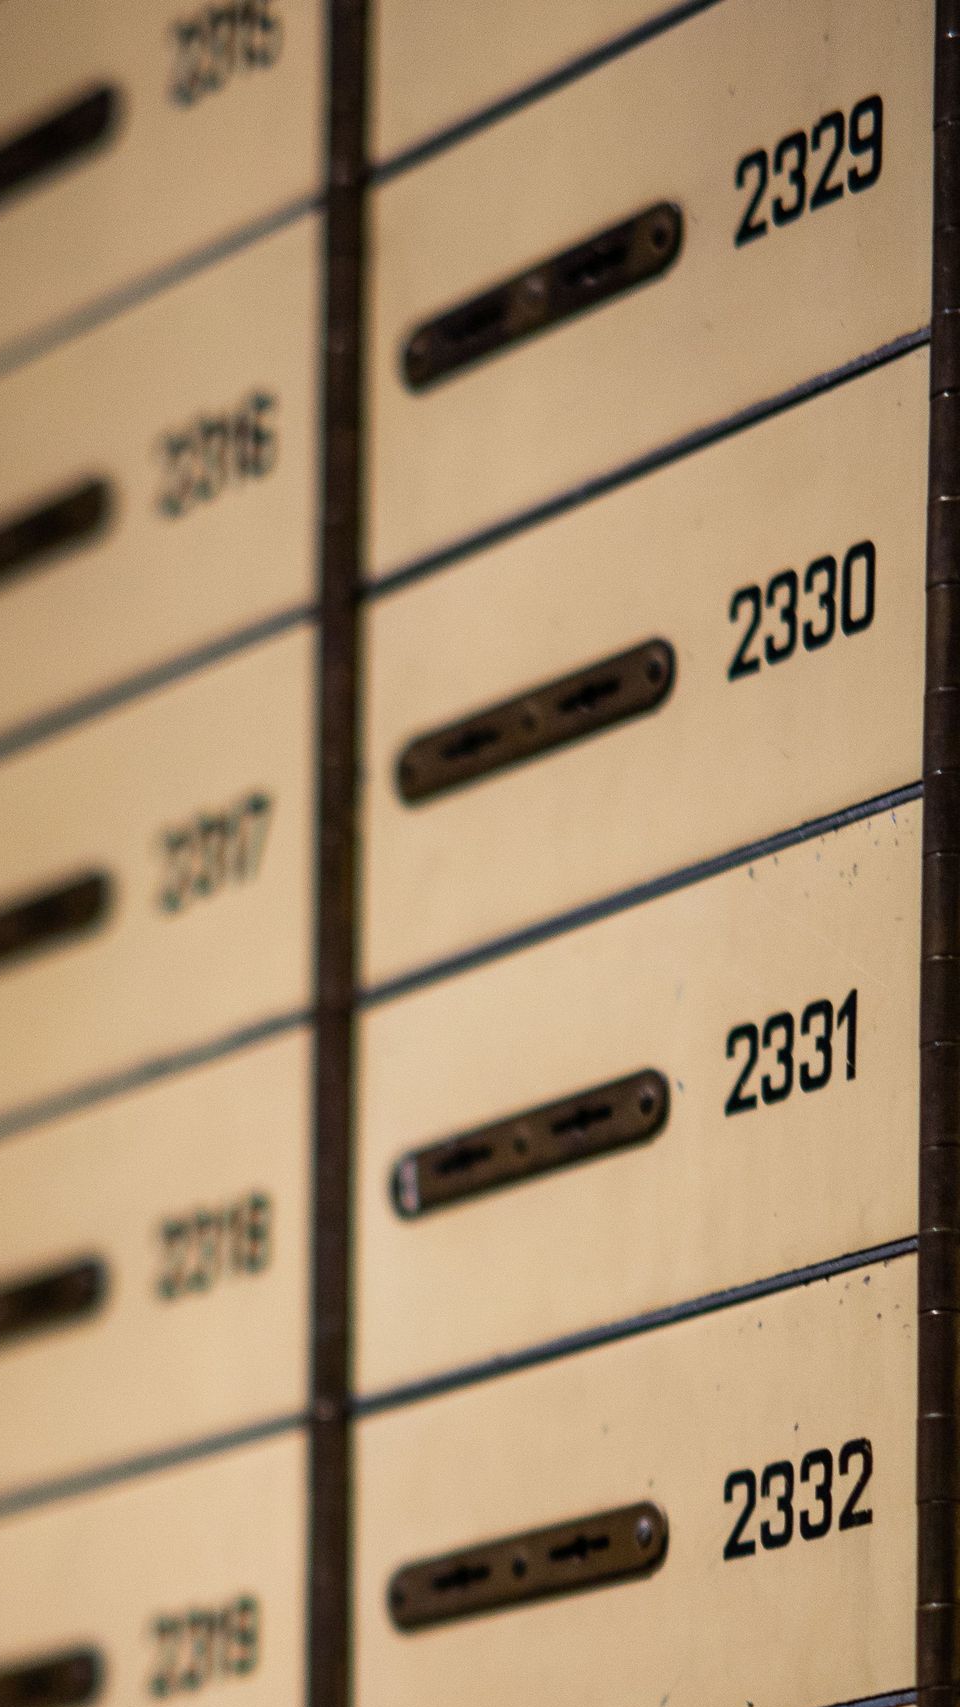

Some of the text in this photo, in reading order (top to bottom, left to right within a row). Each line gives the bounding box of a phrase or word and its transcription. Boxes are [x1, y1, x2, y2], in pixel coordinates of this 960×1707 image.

[735, 94, 883, 247] 2329
[159, 392, 275, 518] 2316
[728, 540, 876, 681] 2330
[160, 792, 272, 913] 2317
[725, 989, 857, 1116] 2331
[156, 1192, 271, 1302] 2318
[723, 1438, 873, 1561] 2332
[148, 1595, 259, 1700] 2319
